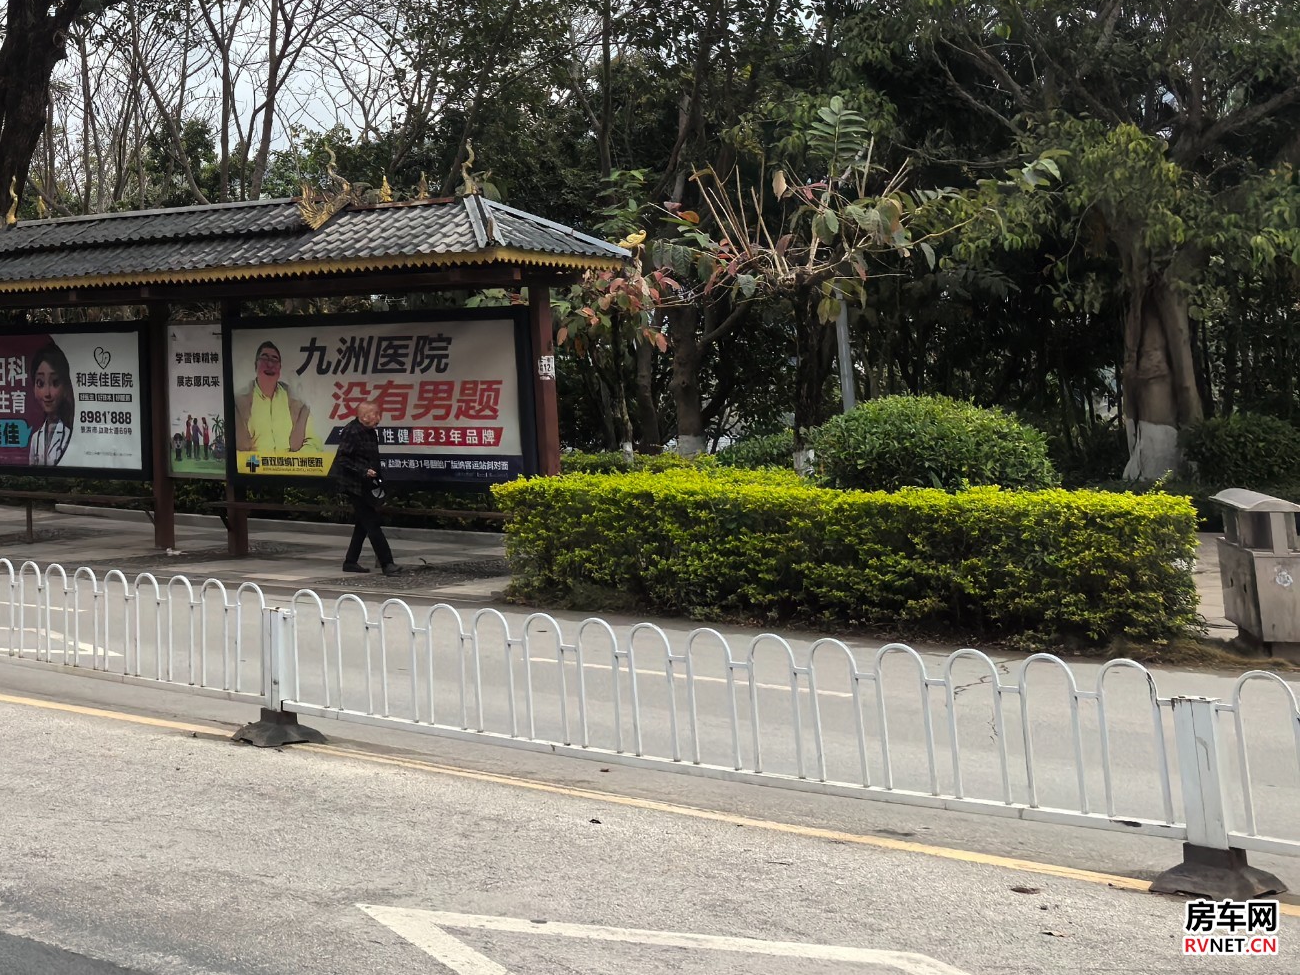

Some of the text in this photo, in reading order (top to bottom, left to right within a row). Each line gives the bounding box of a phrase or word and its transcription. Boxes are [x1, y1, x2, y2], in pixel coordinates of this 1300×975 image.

[175, 352, 219, 364] 学雷锋精神
[295, 333, 453, 376] 九洲医院
[76, 372, 134, 388] 和美佳医院
[177, 375, 220, 387] 展志愿风采
[328, 380, 503, 421] 没有男题
[339, 428, 496, 445] 性健康23年品牌
